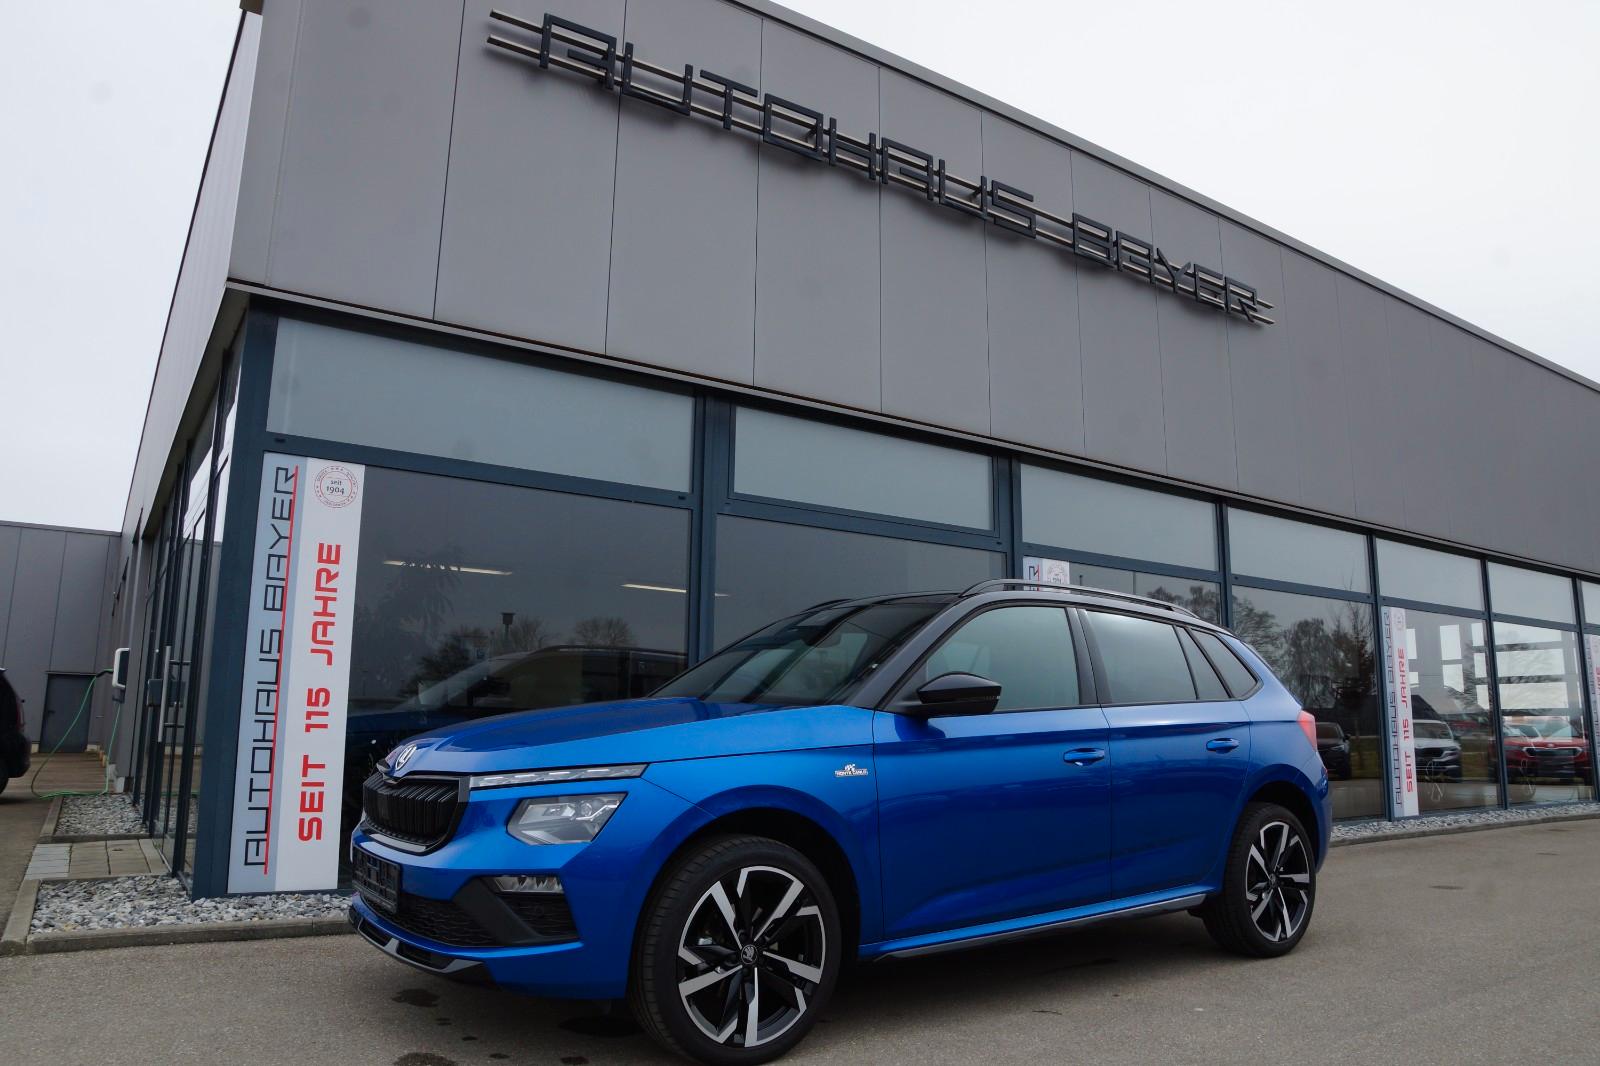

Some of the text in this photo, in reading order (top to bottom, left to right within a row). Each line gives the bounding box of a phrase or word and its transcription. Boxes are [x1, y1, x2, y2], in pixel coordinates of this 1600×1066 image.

[539, 13, 1258, 322] AUTOHAUS BAYER
[326, 485, 345, 495] 1904
[244, 466, 297, 866] AUTOHAUS BAYER
[298, 542, 341, 842] SEIT 115 JAHRE
[1398, 647, 1414, 793] SEIT 115 JAHRE
